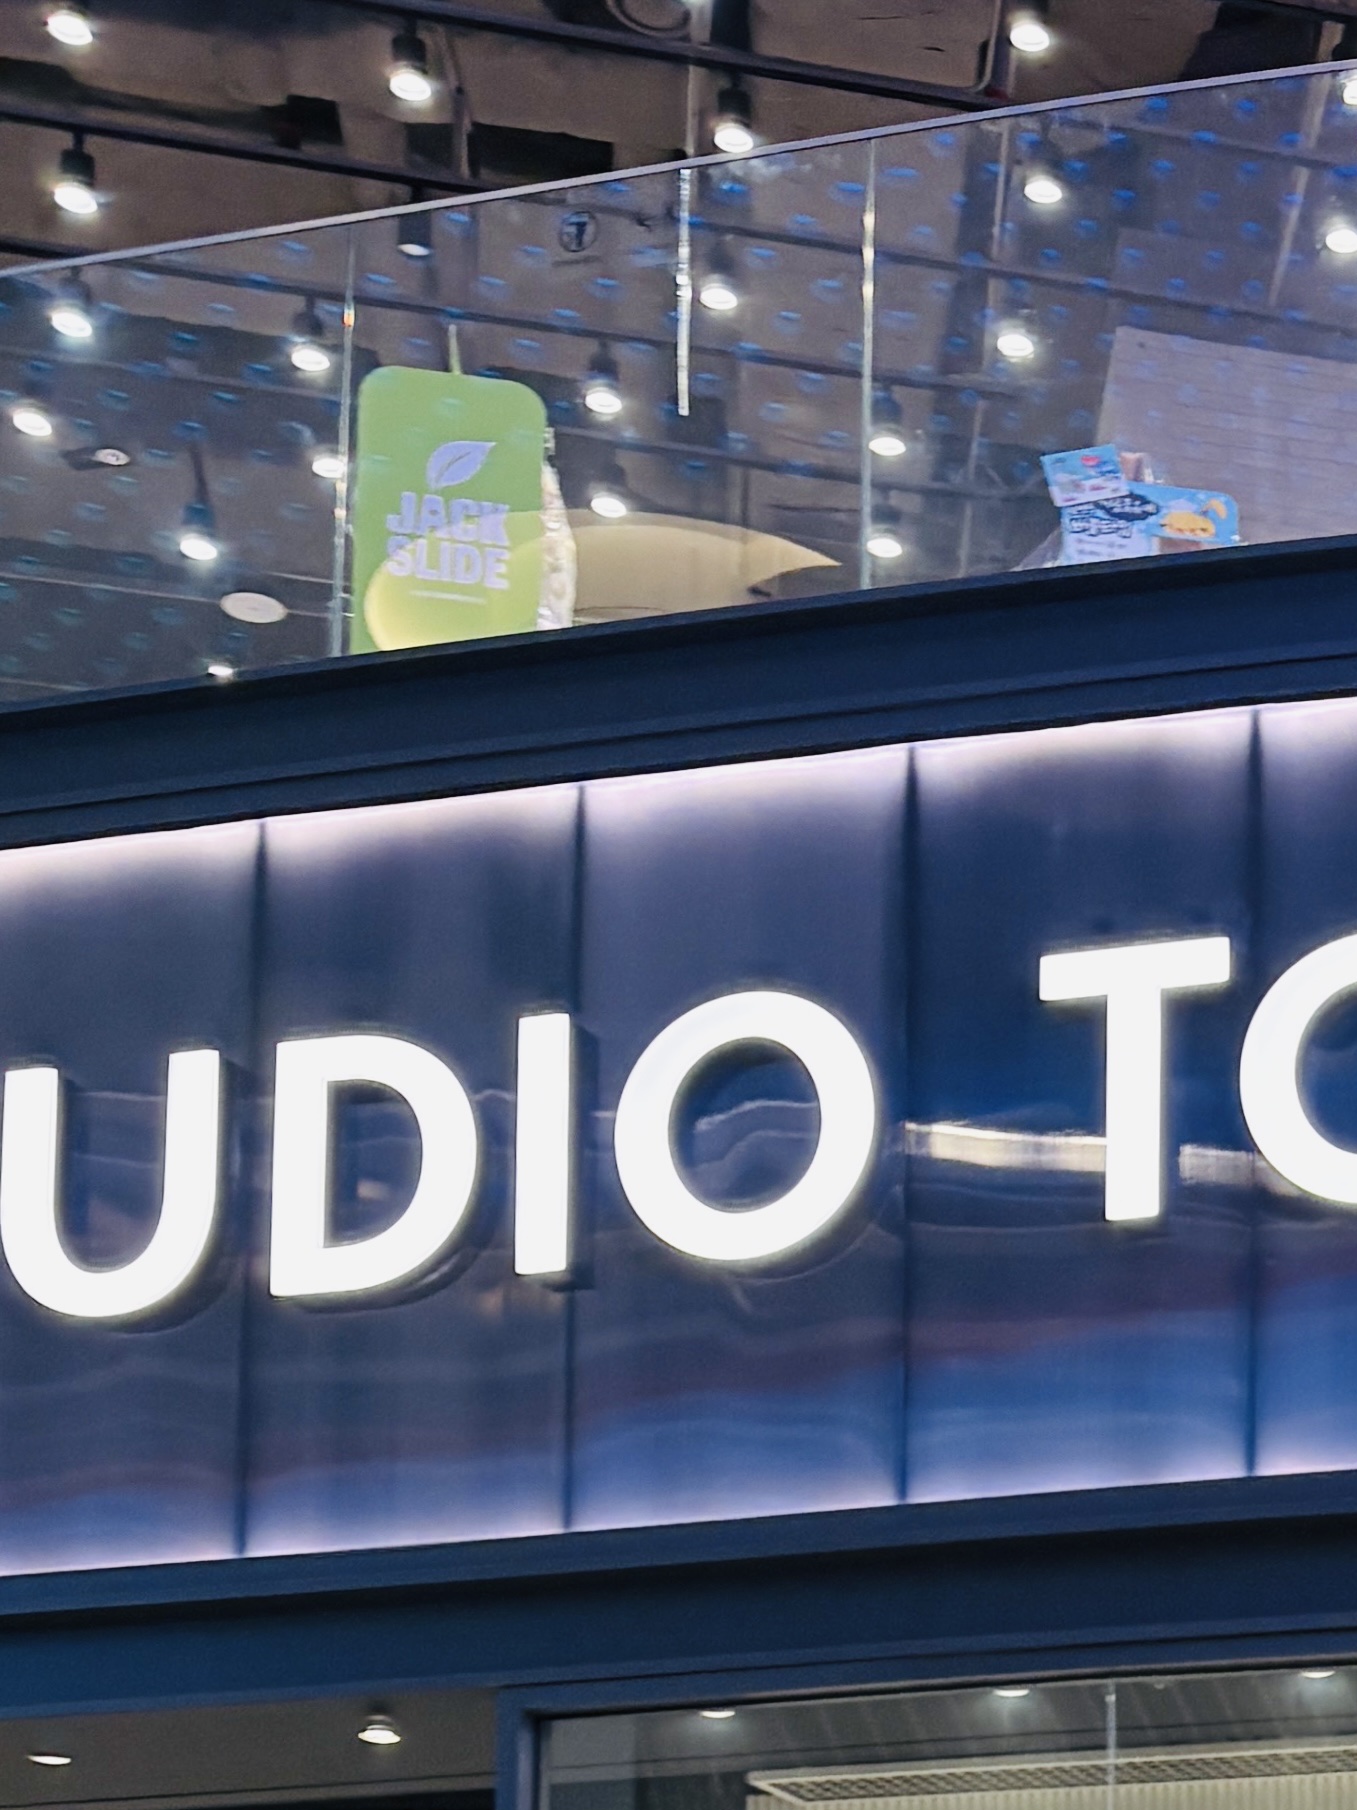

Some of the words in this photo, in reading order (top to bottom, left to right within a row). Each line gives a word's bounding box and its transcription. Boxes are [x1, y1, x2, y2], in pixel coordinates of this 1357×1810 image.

[386, 491, 511, 546] JACK
[385, 535, 511, 590] SLIDE
[0, 990, 876, 1318] UDIO
